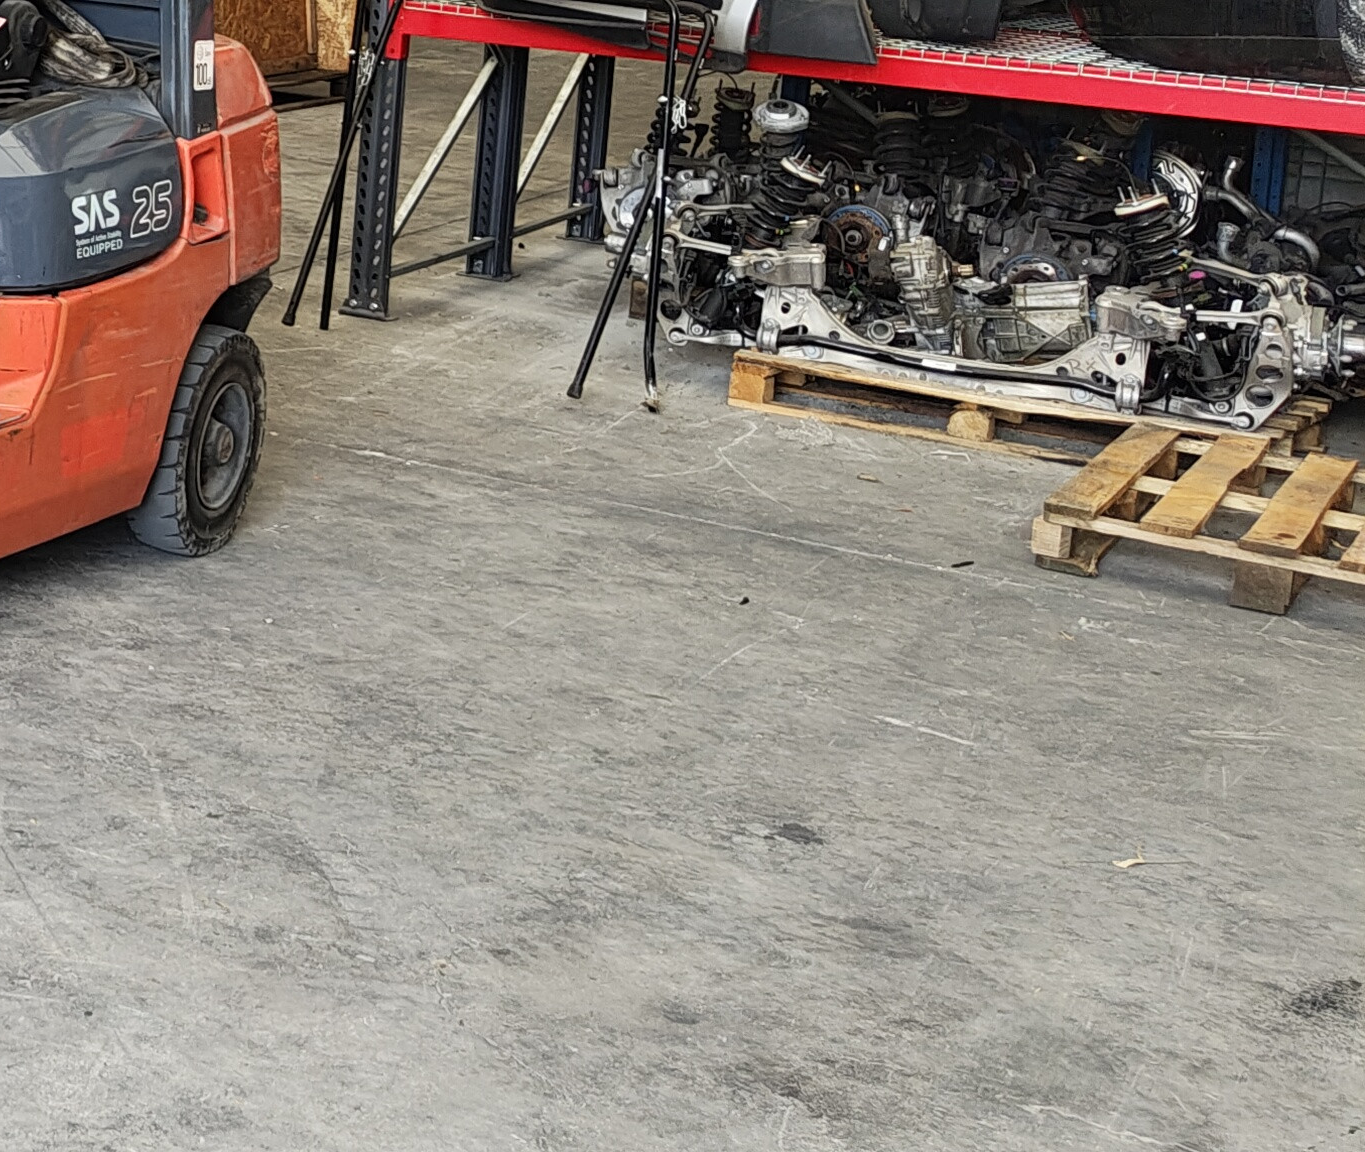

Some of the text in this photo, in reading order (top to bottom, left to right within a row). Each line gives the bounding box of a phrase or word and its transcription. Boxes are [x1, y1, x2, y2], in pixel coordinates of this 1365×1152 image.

[196, 62, 208, 86] 100
[71, 179, 172, 239] SAS 25
[76, 239, 123, 259] EQUIPPED
